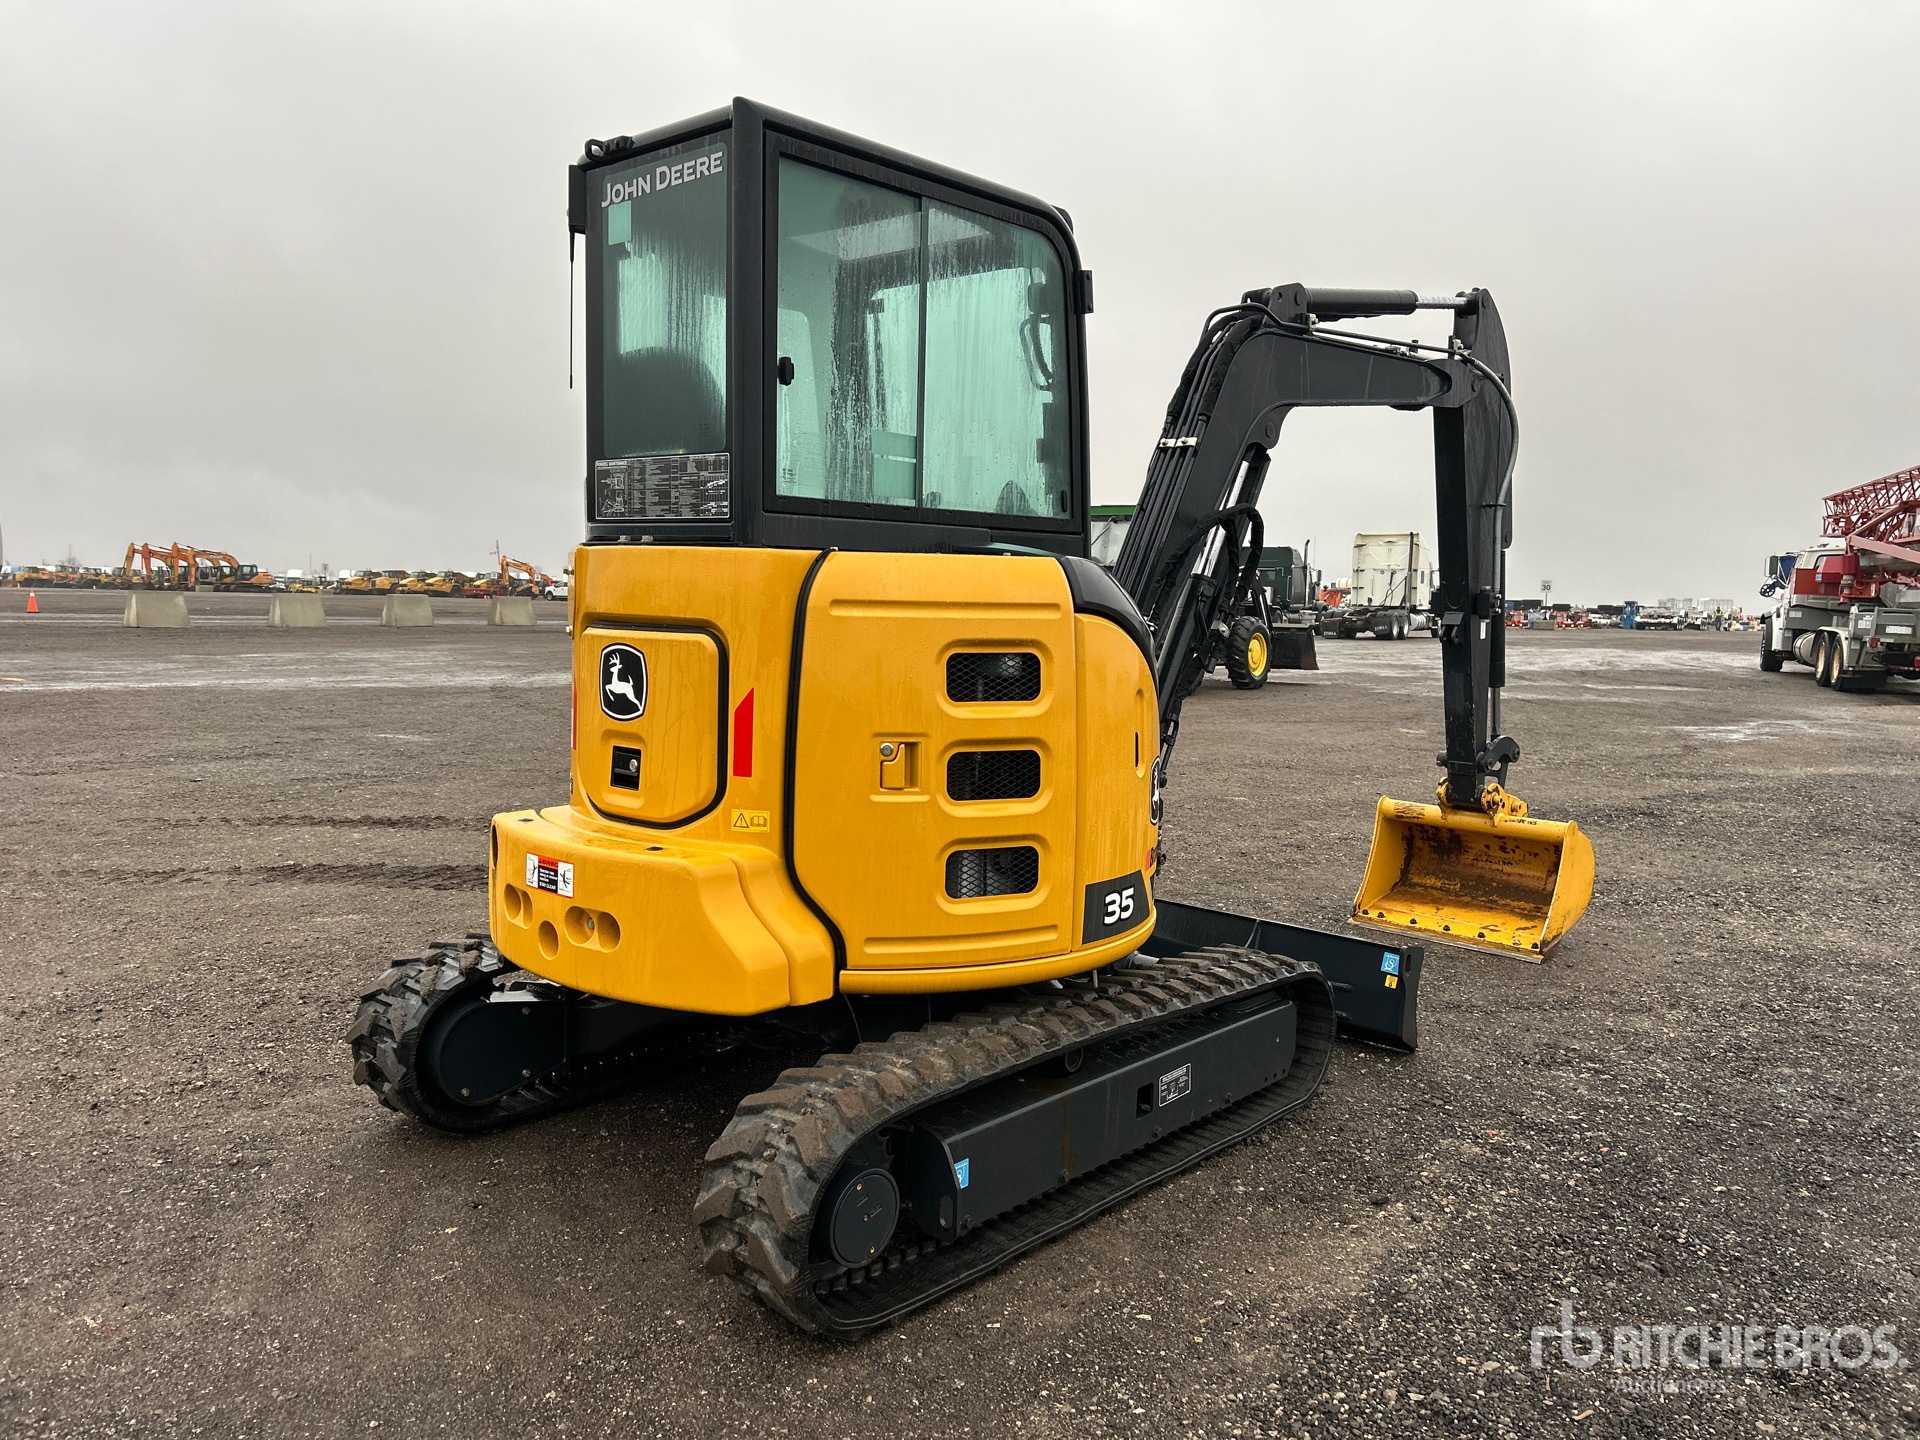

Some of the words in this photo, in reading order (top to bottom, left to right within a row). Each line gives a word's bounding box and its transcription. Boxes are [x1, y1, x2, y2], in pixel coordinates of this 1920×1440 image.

[602, 174, 651, 208] JOHN
[656, 151, 723, 191] DEERE
[1103, 886, 1135, 924] 35
